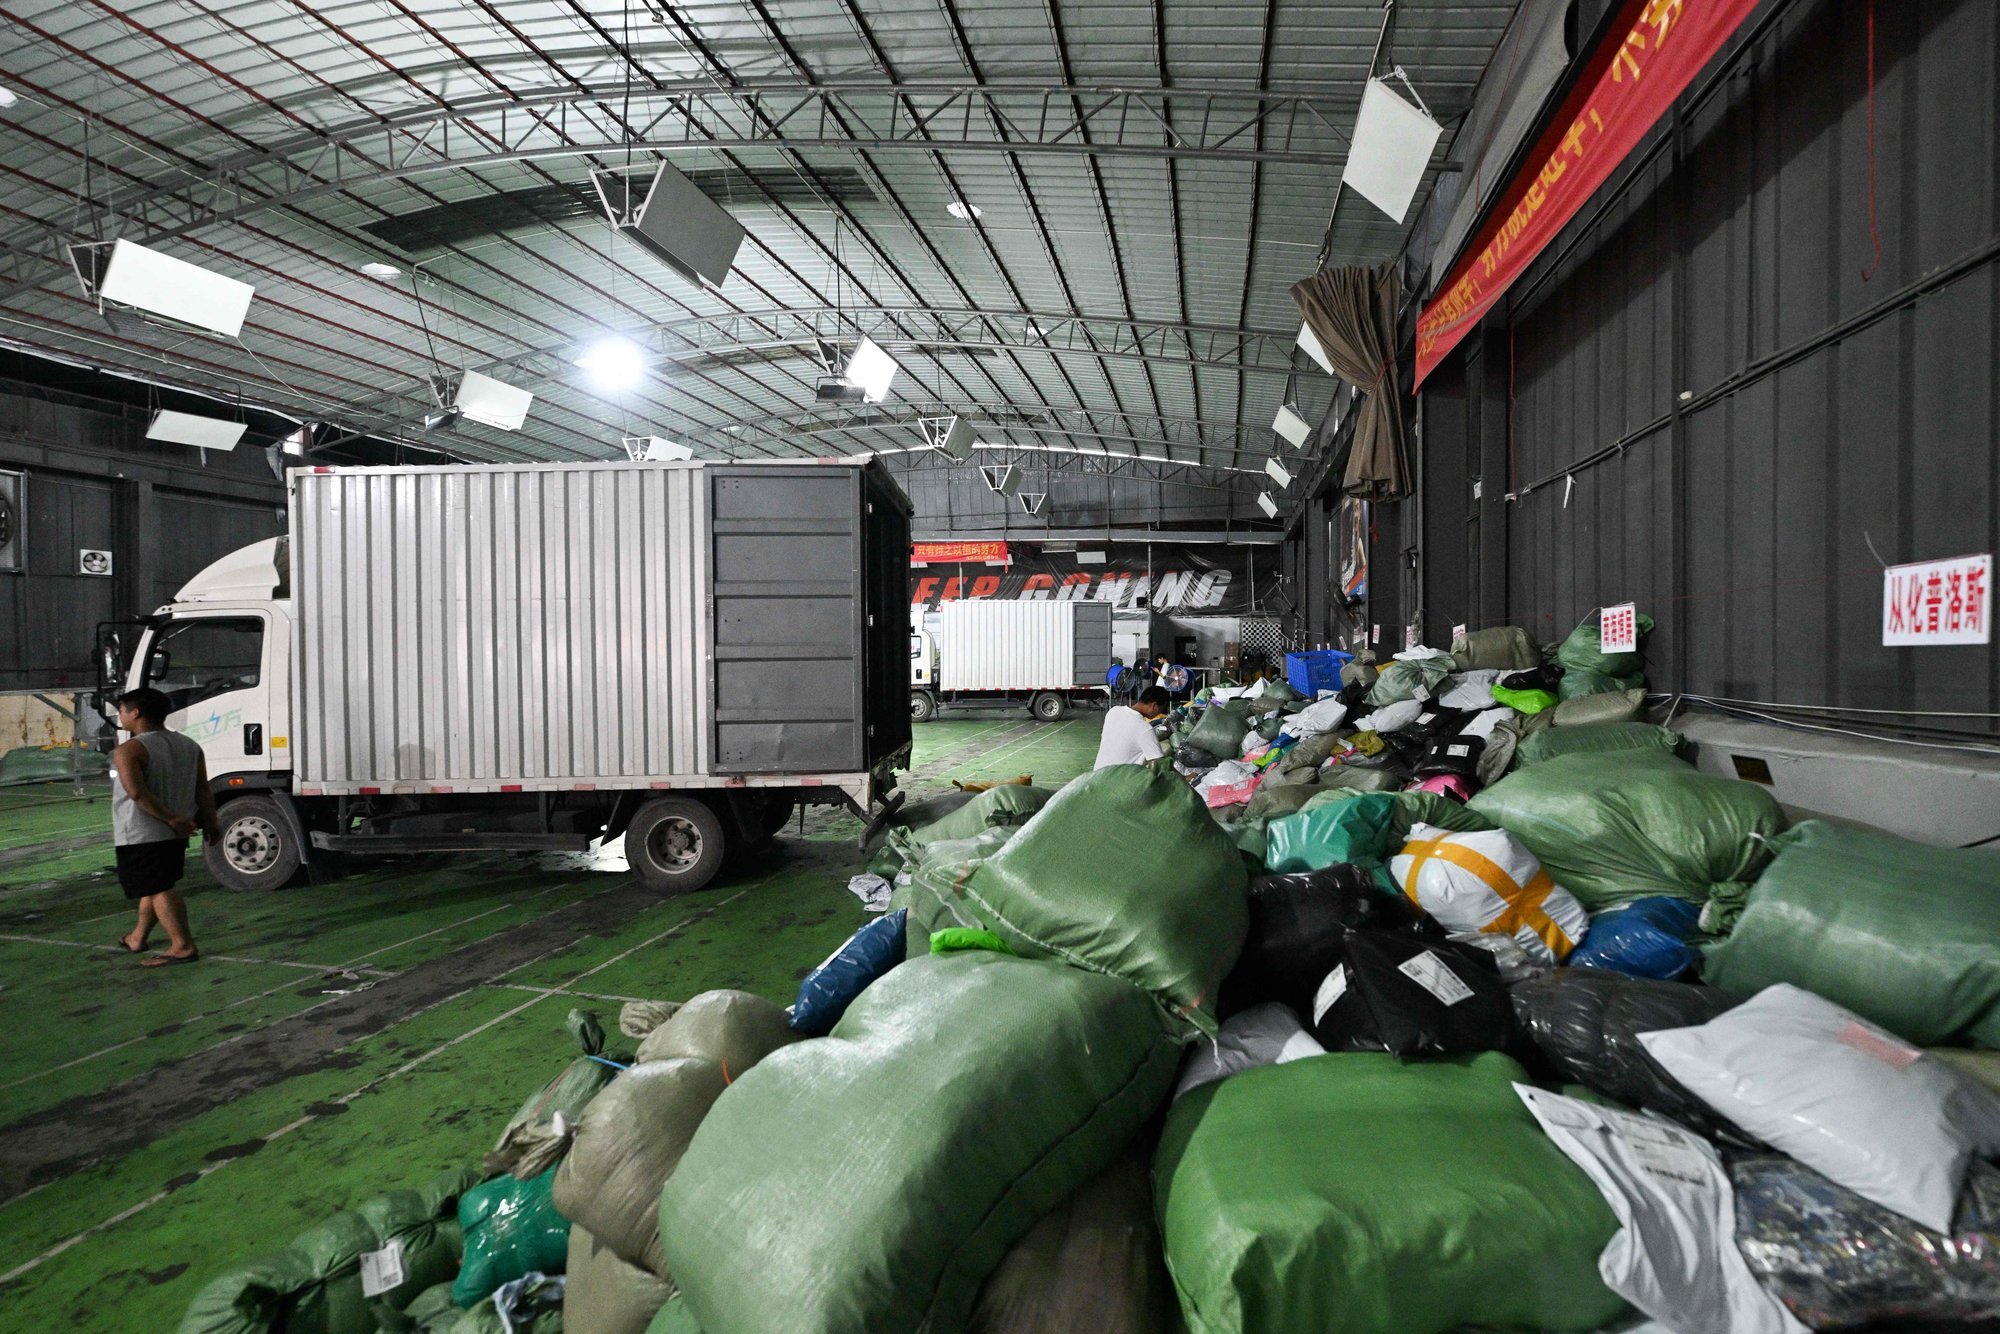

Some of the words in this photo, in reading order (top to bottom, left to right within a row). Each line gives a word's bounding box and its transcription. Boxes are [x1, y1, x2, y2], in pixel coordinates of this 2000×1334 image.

[917, 543, 999, 556] 只有持之以恒的努力
[911, 576, 1001, 611] EEP
[1888, 566, 1985, 634] 从化普洛斯
